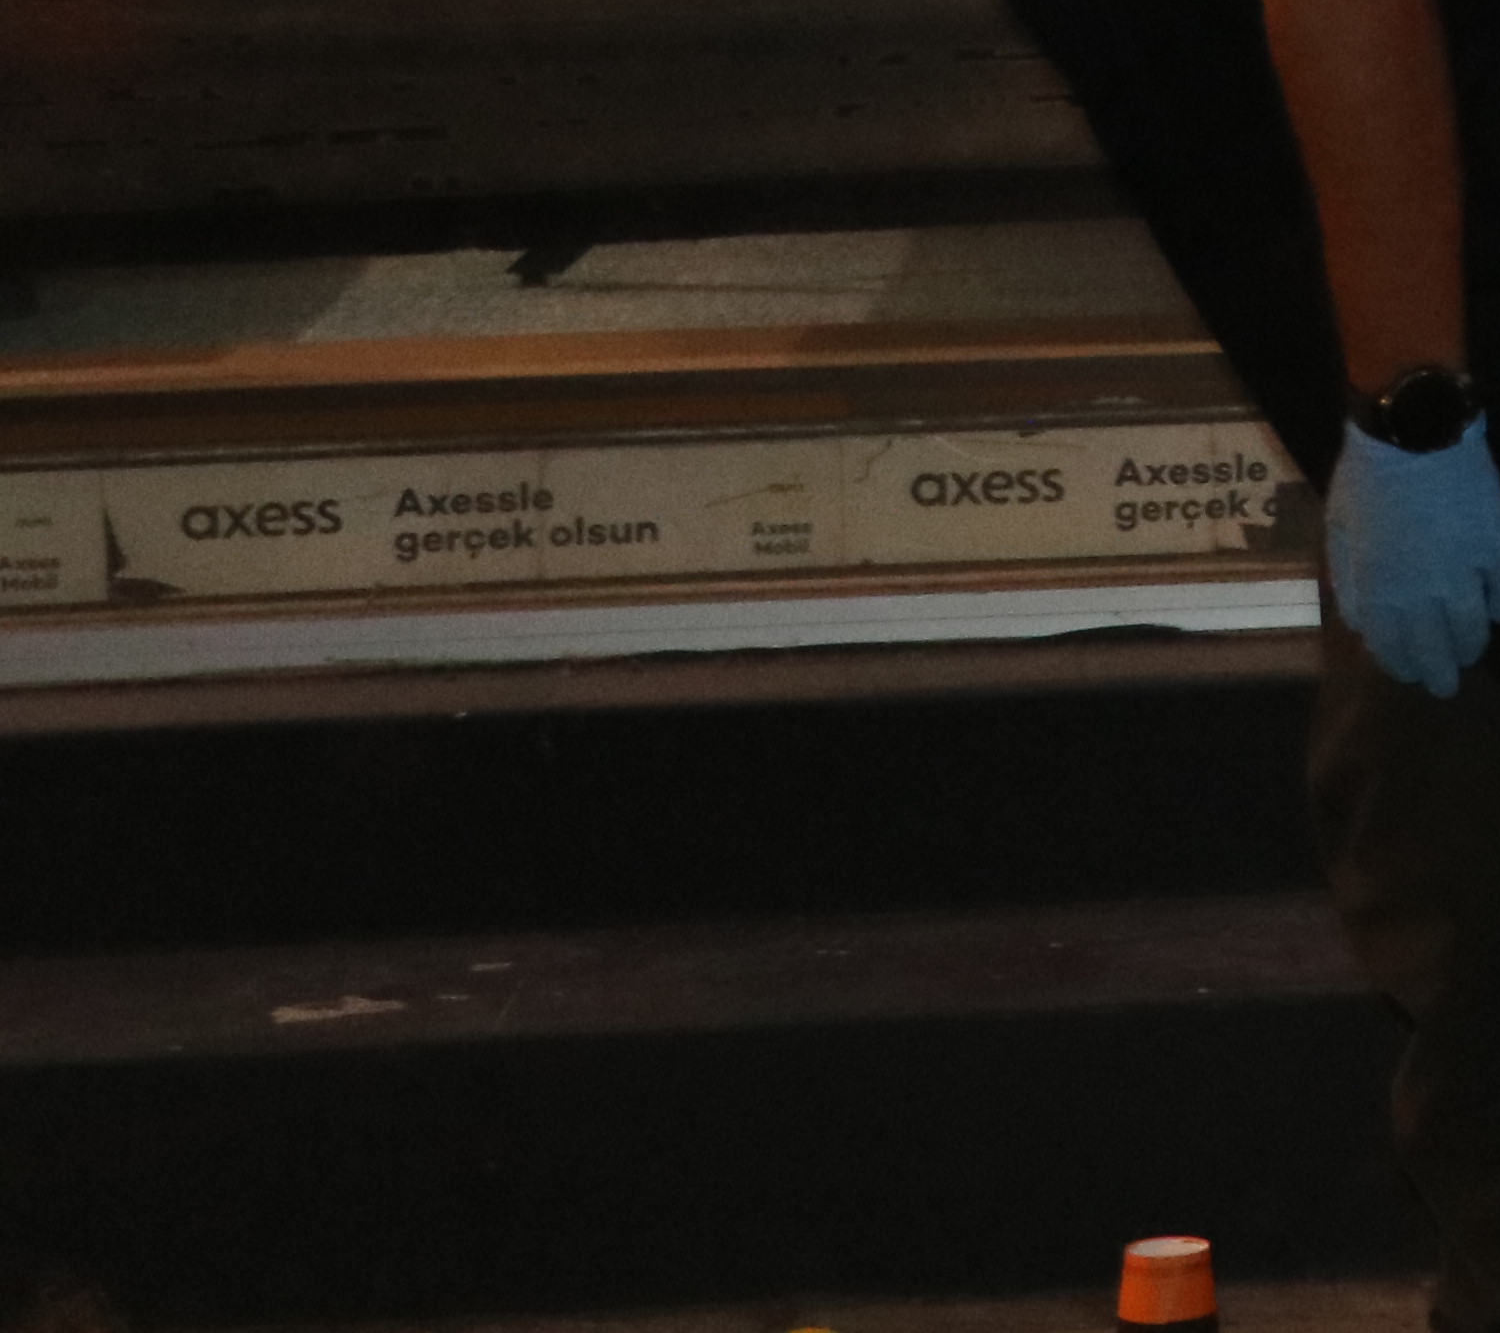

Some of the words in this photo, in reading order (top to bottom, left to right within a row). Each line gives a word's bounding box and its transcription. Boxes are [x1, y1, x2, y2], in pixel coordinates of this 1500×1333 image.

[910, 467, 1065, 508] axess
[1115, 453, 1269, 488] Axessle
[180, 497, 343, 542] axess
[394, 481, 555, 518] Axessle
[1115, 489, 1250, 531] gerçek
[394, 518, 535, 563] gerçek
[549, 516, 660, 548] olsun
